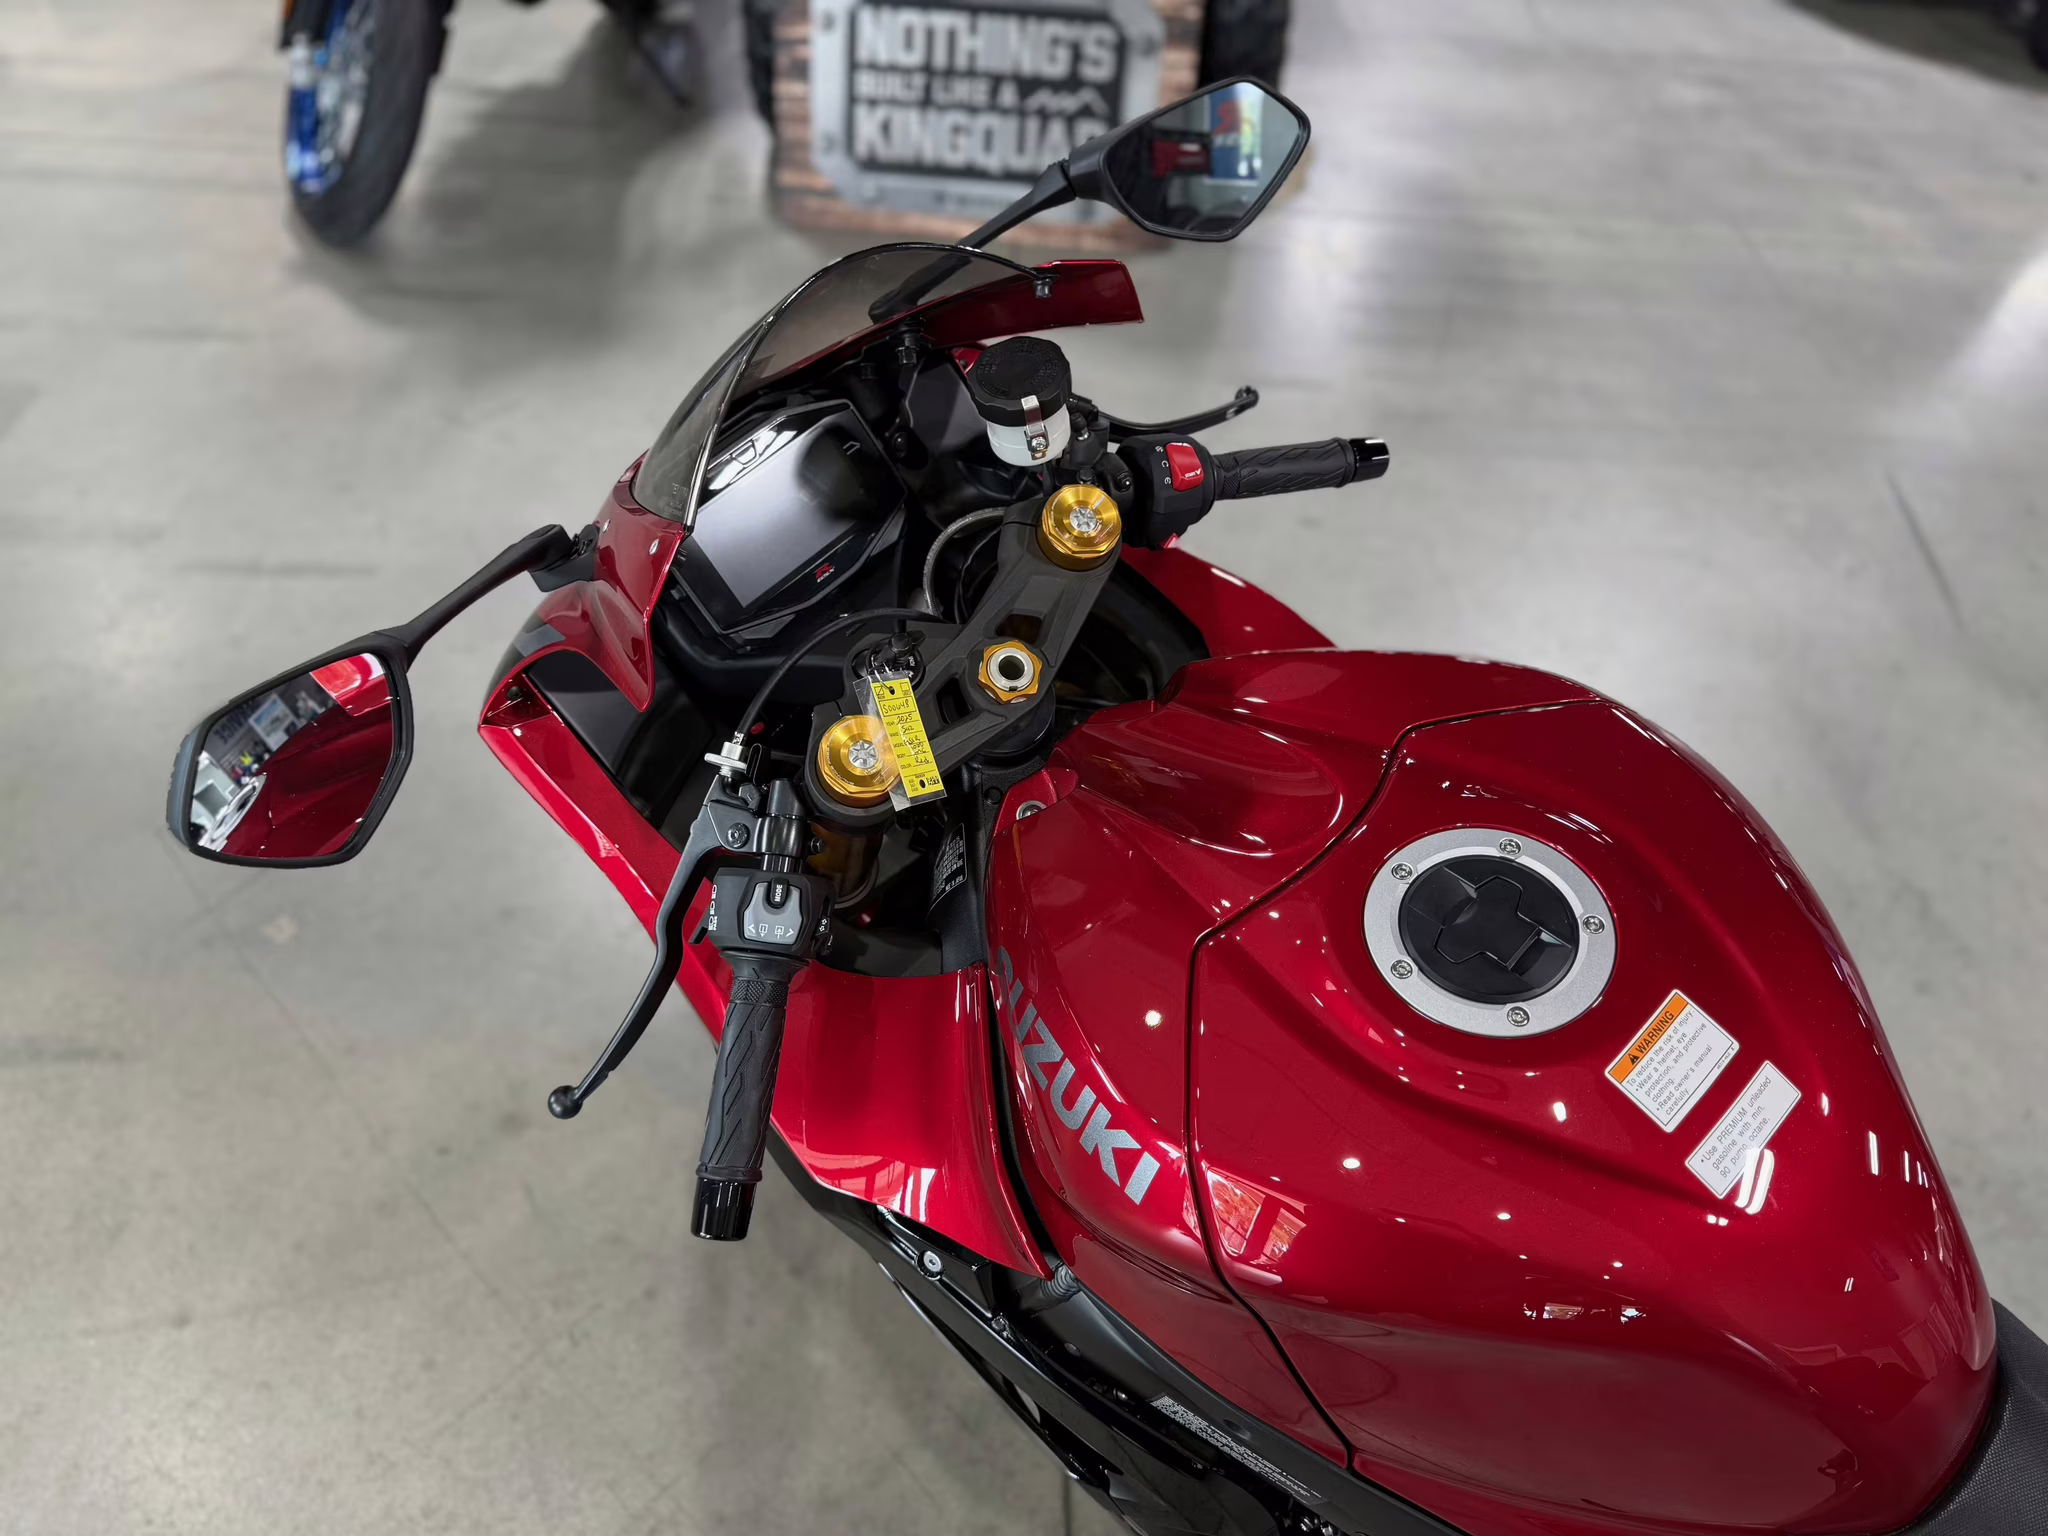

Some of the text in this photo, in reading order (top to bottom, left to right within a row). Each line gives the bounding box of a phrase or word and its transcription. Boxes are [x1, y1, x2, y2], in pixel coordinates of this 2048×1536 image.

[854, 5, 1118, 83] NOTHING'S
[774, 884, 783, 902] MODE
[1626, 1078, 1636, 1086] To
[1635, 1056, 1654, 1078] reduce
[1653, 1046, 1664, 1056] the
[1663, 1034, 1673, 1045] risk
[1672, 1026, 1679, 1034] of
[1635, 1011, 1674, 1053] WARNING
[1636, 1072, 1652, 1089] Wear
[1676, 1032, 1687, 1044] eye
[1672, 1050, 1683, 1064] and
[1682, 1023, 1706, 1052] protective
[1658, 1044, 1712, 1109] Read owner's manual
[1702, 1076, 1771, 1160] Use PREMIUM unleaded
[1712, 1106, 1765, 1170] gasoline with min.
[1720, 1166, 1730, 1178] 90
[1748, 1117, 1770, 1141] octane.
